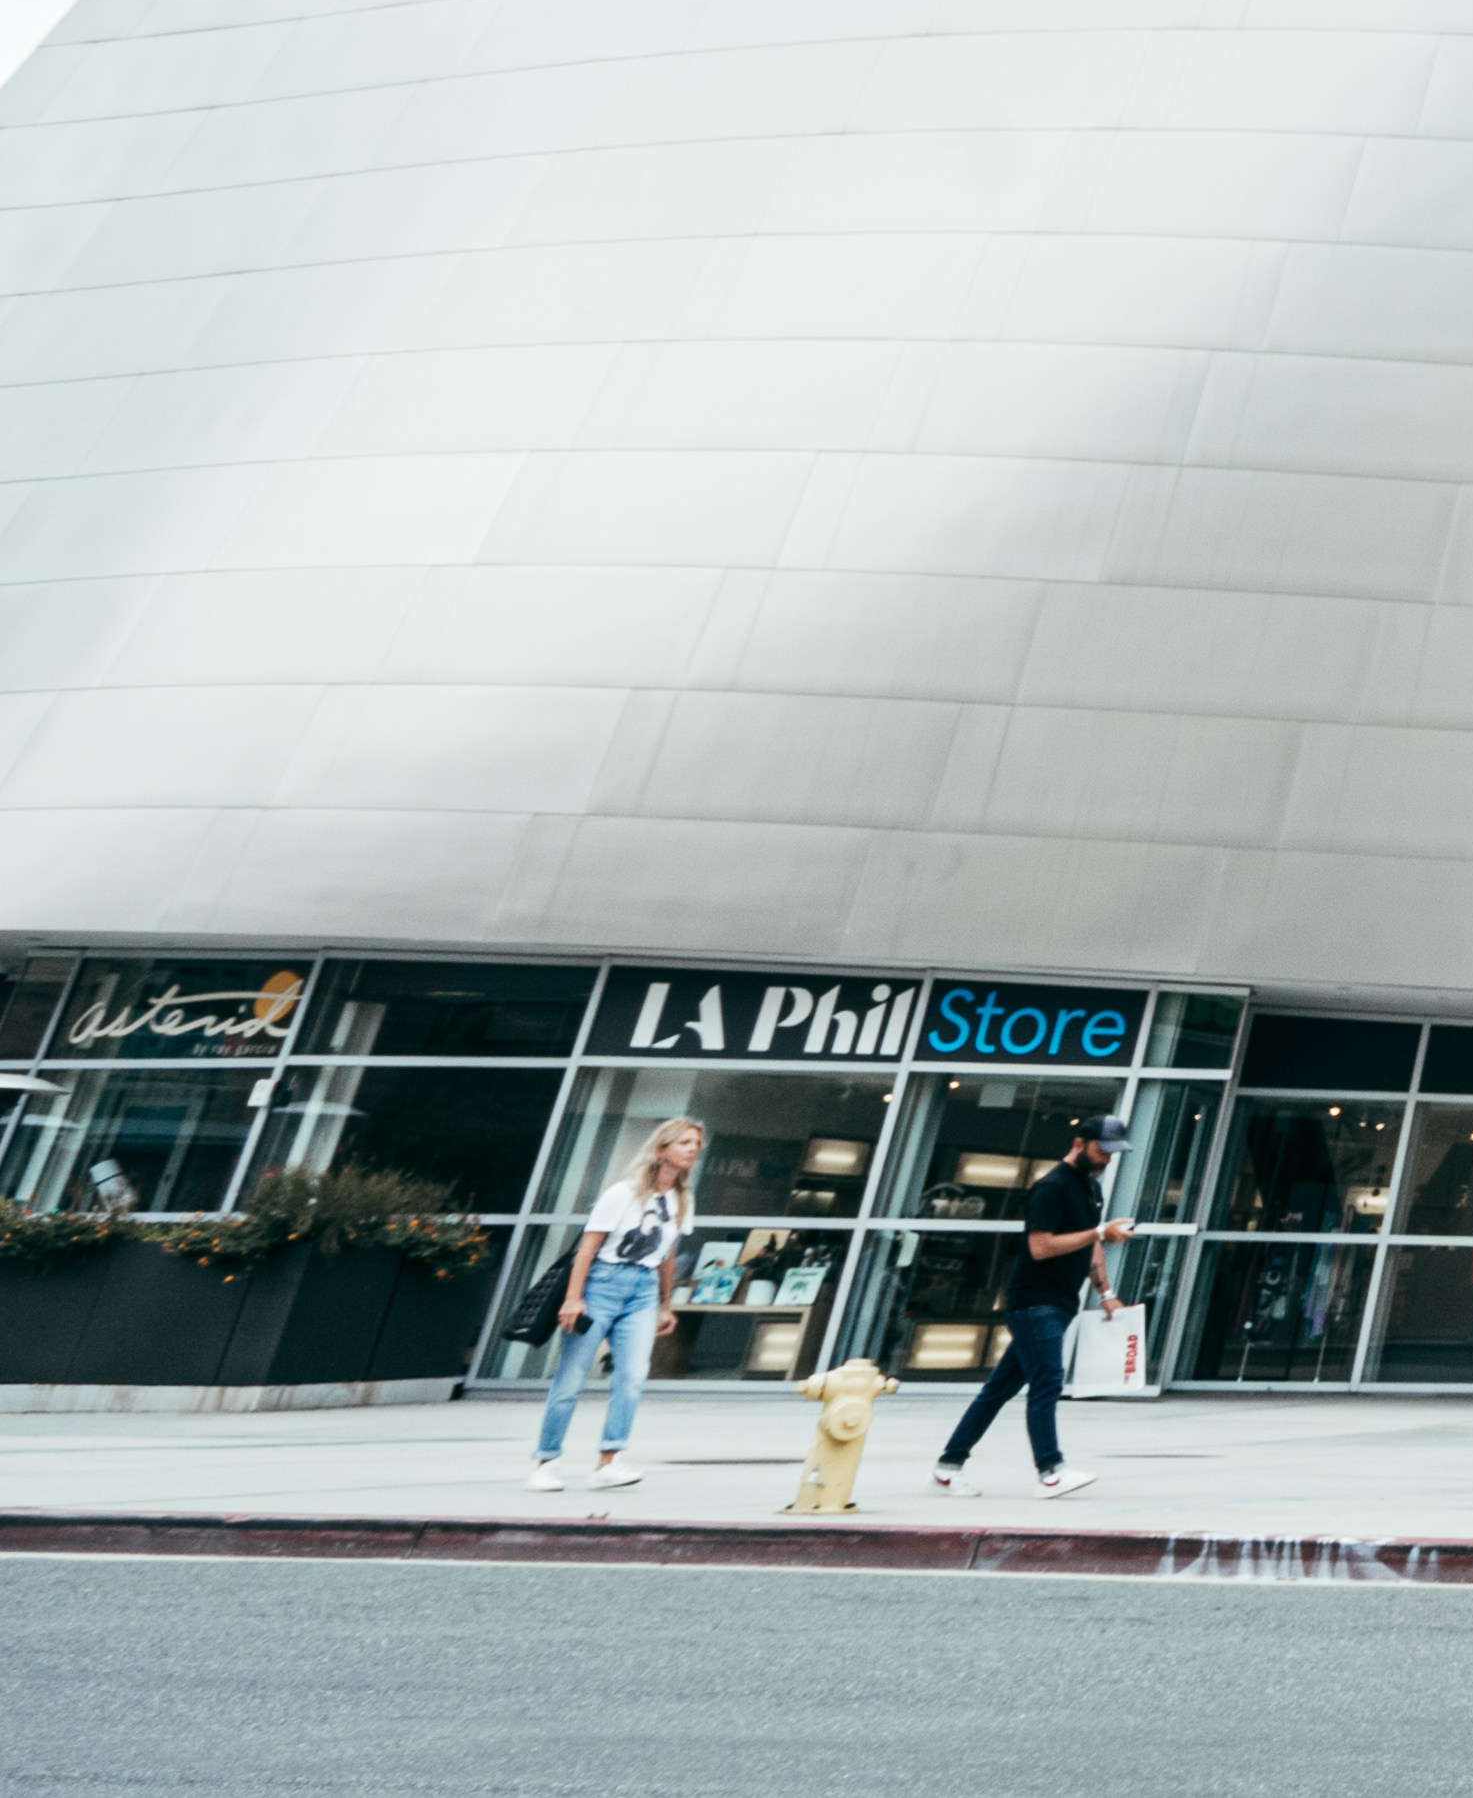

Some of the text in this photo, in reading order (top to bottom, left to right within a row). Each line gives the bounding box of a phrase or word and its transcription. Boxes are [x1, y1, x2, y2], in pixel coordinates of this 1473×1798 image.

[69, 979, 304, 1044] asterid
[630, 982, 1126, 1057] LA Phil Store
[1124, 1334, 1139, 1374] BROAD
